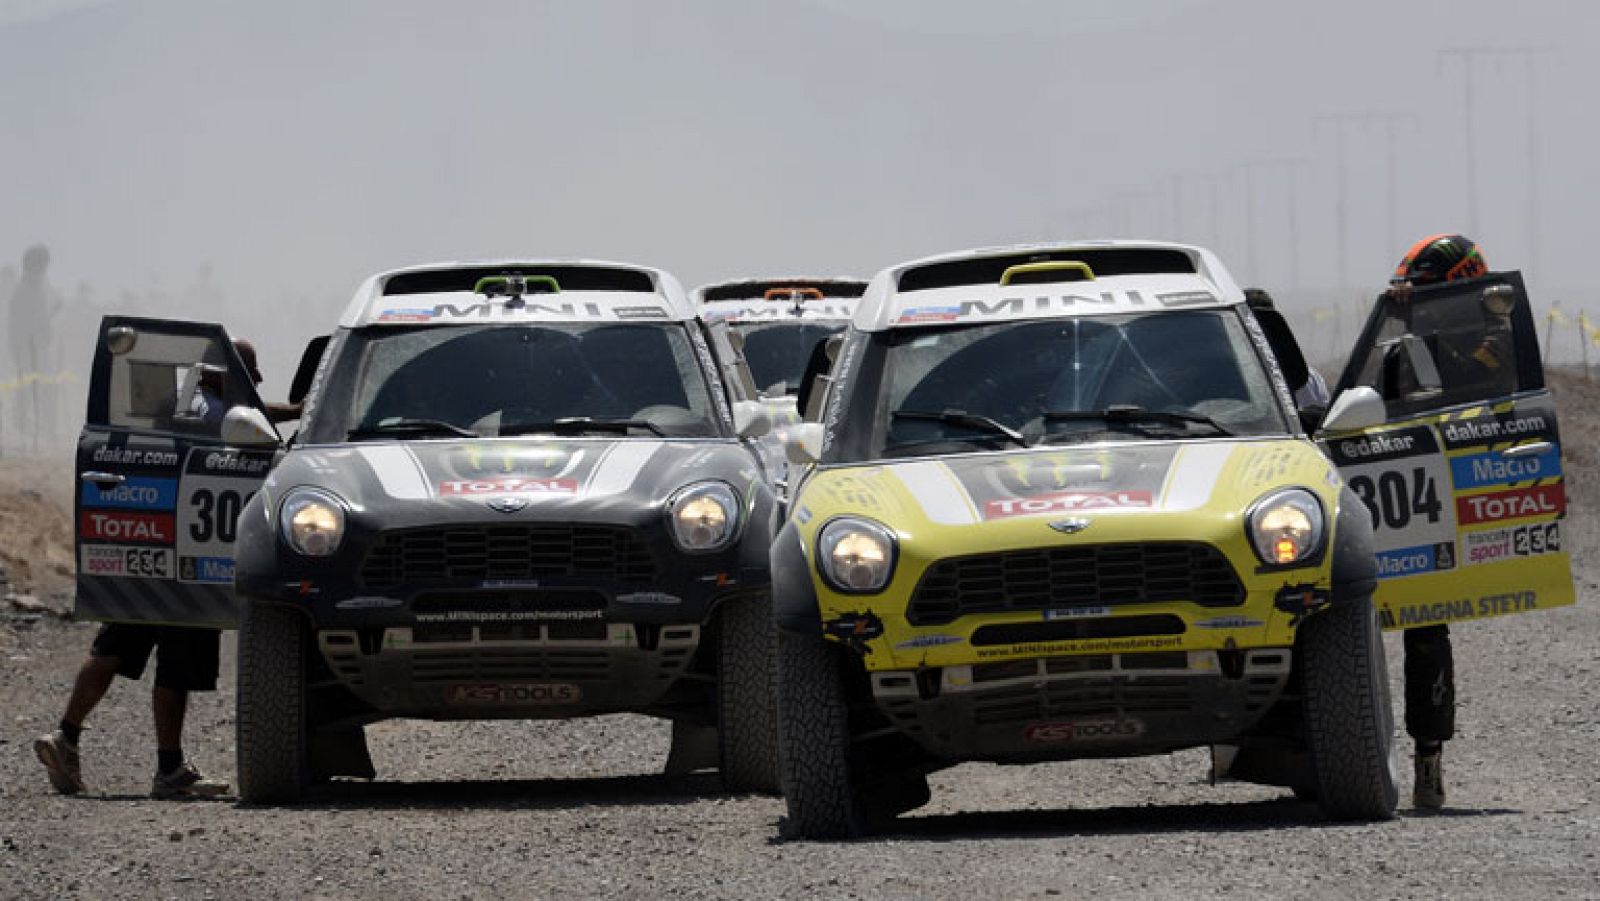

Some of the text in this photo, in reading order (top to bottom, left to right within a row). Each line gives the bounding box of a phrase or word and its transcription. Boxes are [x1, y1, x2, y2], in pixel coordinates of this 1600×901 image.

[959, 290, 1145, 315] MINI
[1446, 415, 1547, 441] dakar.com
[93, 443, 178, 466] dakar.com
[1340, 434, 1415, 458] @dakar
[205, 451, 269, 472] @dakar
[1472, 457, 1540, 481] Macro
[444, 480, 574, 494] TOTAL
[989, 494, 1148, 514] TOTAL
[1350, 467, 1442, 532] 304
[190, 487, 257, 543] 30
[1470, 533, 1509, 563] sport
[88, 557, 123, 575] sport
[1401, 599, 1474, 625] MAGNA
[1478, 591, 1537, 616] STEYR
